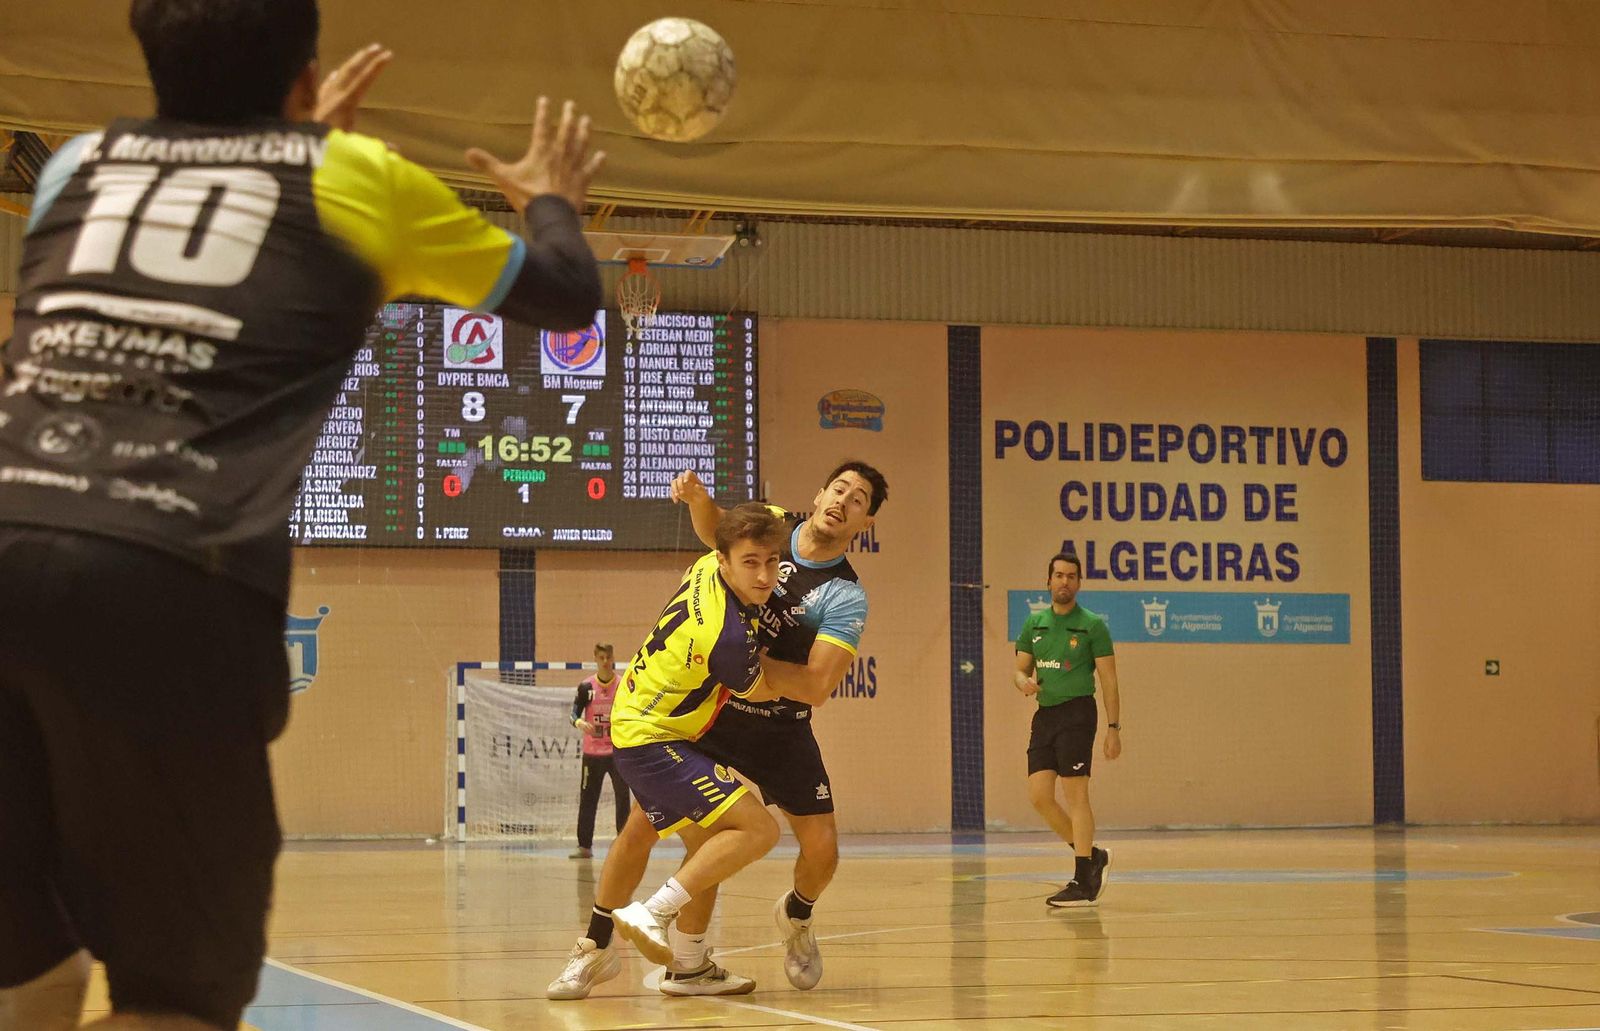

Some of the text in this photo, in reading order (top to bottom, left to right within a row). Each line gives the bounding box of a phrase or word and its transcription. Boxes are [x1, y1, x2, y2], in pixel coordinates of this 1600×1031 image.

[68, 163, 281, 288] 10
[418, 307, 424, 319] 1
[417, 322, 424, 333] 0
[698, 315, 714, 329] GA
[417, 336, 424, 348] 0
[640, 329, 682, 342] ESTEBAN
[745, 332, 752, 343] 3
[418, 351, 424, 362] 1
[626, 342, 633, 354] 8
[639, 342, 677, 355] ADRIAN
[745, 347, 752, 358] 2
[354, 363, 380, 376] RIOS
[417, 365, 424, 377] 0
[624, 356, 635, 369] 10
[640, 357, 679, 370] MANUEL
[438, 372, 510, 387] DYPRE BMCA
[543, 375, 604, 390] BM Moguer
[624, 371, 634, 383] 11
[639, 371, 663, 384] JOSE
[665, 372, 697, 385] ANGEL
[699, 373, 715, 385] LO
[417, 380, 424, 392] 0
[624, 385, 636, 398] 12
[667, 386, 695, 399] TORO
[417, 394, 424, 406] 0
[461, 391, 486, 422] 8
[624, 399, 636, 412] 14
[640, 400, 683, 413] ANTONIO
[686, 401, 709, 413] DIAZ
[417, 409, 424, 421] 0
[561, 394, 586, 425] 7
[624, 414, 636, 426] 16
[640, 414, 696, 427] ALEJANDRO
[699, 415, 714, 428] GU
[417, 423, 424, 435] 5
[444, 428, 460, 438] TM
[588, 431, 605, 440] TM
[624, 428, 636, 440] 18
[640, 428, 670, 441] JUSTO
[673, 429, 707, 442] GOMEZ
[316, 435, 424, 450] DIEGUEZ 0
[478, 435, 573, 462] 16:52
[624, 442, 753, 457] 19 JUAN DOMINGU 1
[994, 420, 1349, 467] POLIDEPORTIVO
[417, 452, 424, 464] 0
[436, 459, 468, 467] FALTAS
[623, 457, 637, 470] 23
[640, 457, 697, 470] ALEJANDRO
[417, 467, 424, 479] 0
[581, 462, 612, 470] FALTAS
[503, 469, 546, 482] PERIODO
[623, 471, 637, 484] 24
[304, 480, 424, 495] A.SANZ 0
[443, 474, 462, 497] 0
[587, 477, 606, 500] 0
[623, 485, 753, 499] 33 JAVIER 1
[517, 483, 529, 503] 1
[304, 494, 364, 508] B.VILLALBA
[417, 496, 424, 508] 0
[1060, 480, 1299, 522] CIUDAD DE
[304, 509, 349, 523] M.RIERA
[418, 511, 424, 523] 1
[288, 525, 424, 539] 71 A.GONZALEZ 0
[444, 527, 469, 539] PEREZ
[553, 529, 612, 541] JAVIER OLLERO
[692, 586, 705, 626] MOGUER
